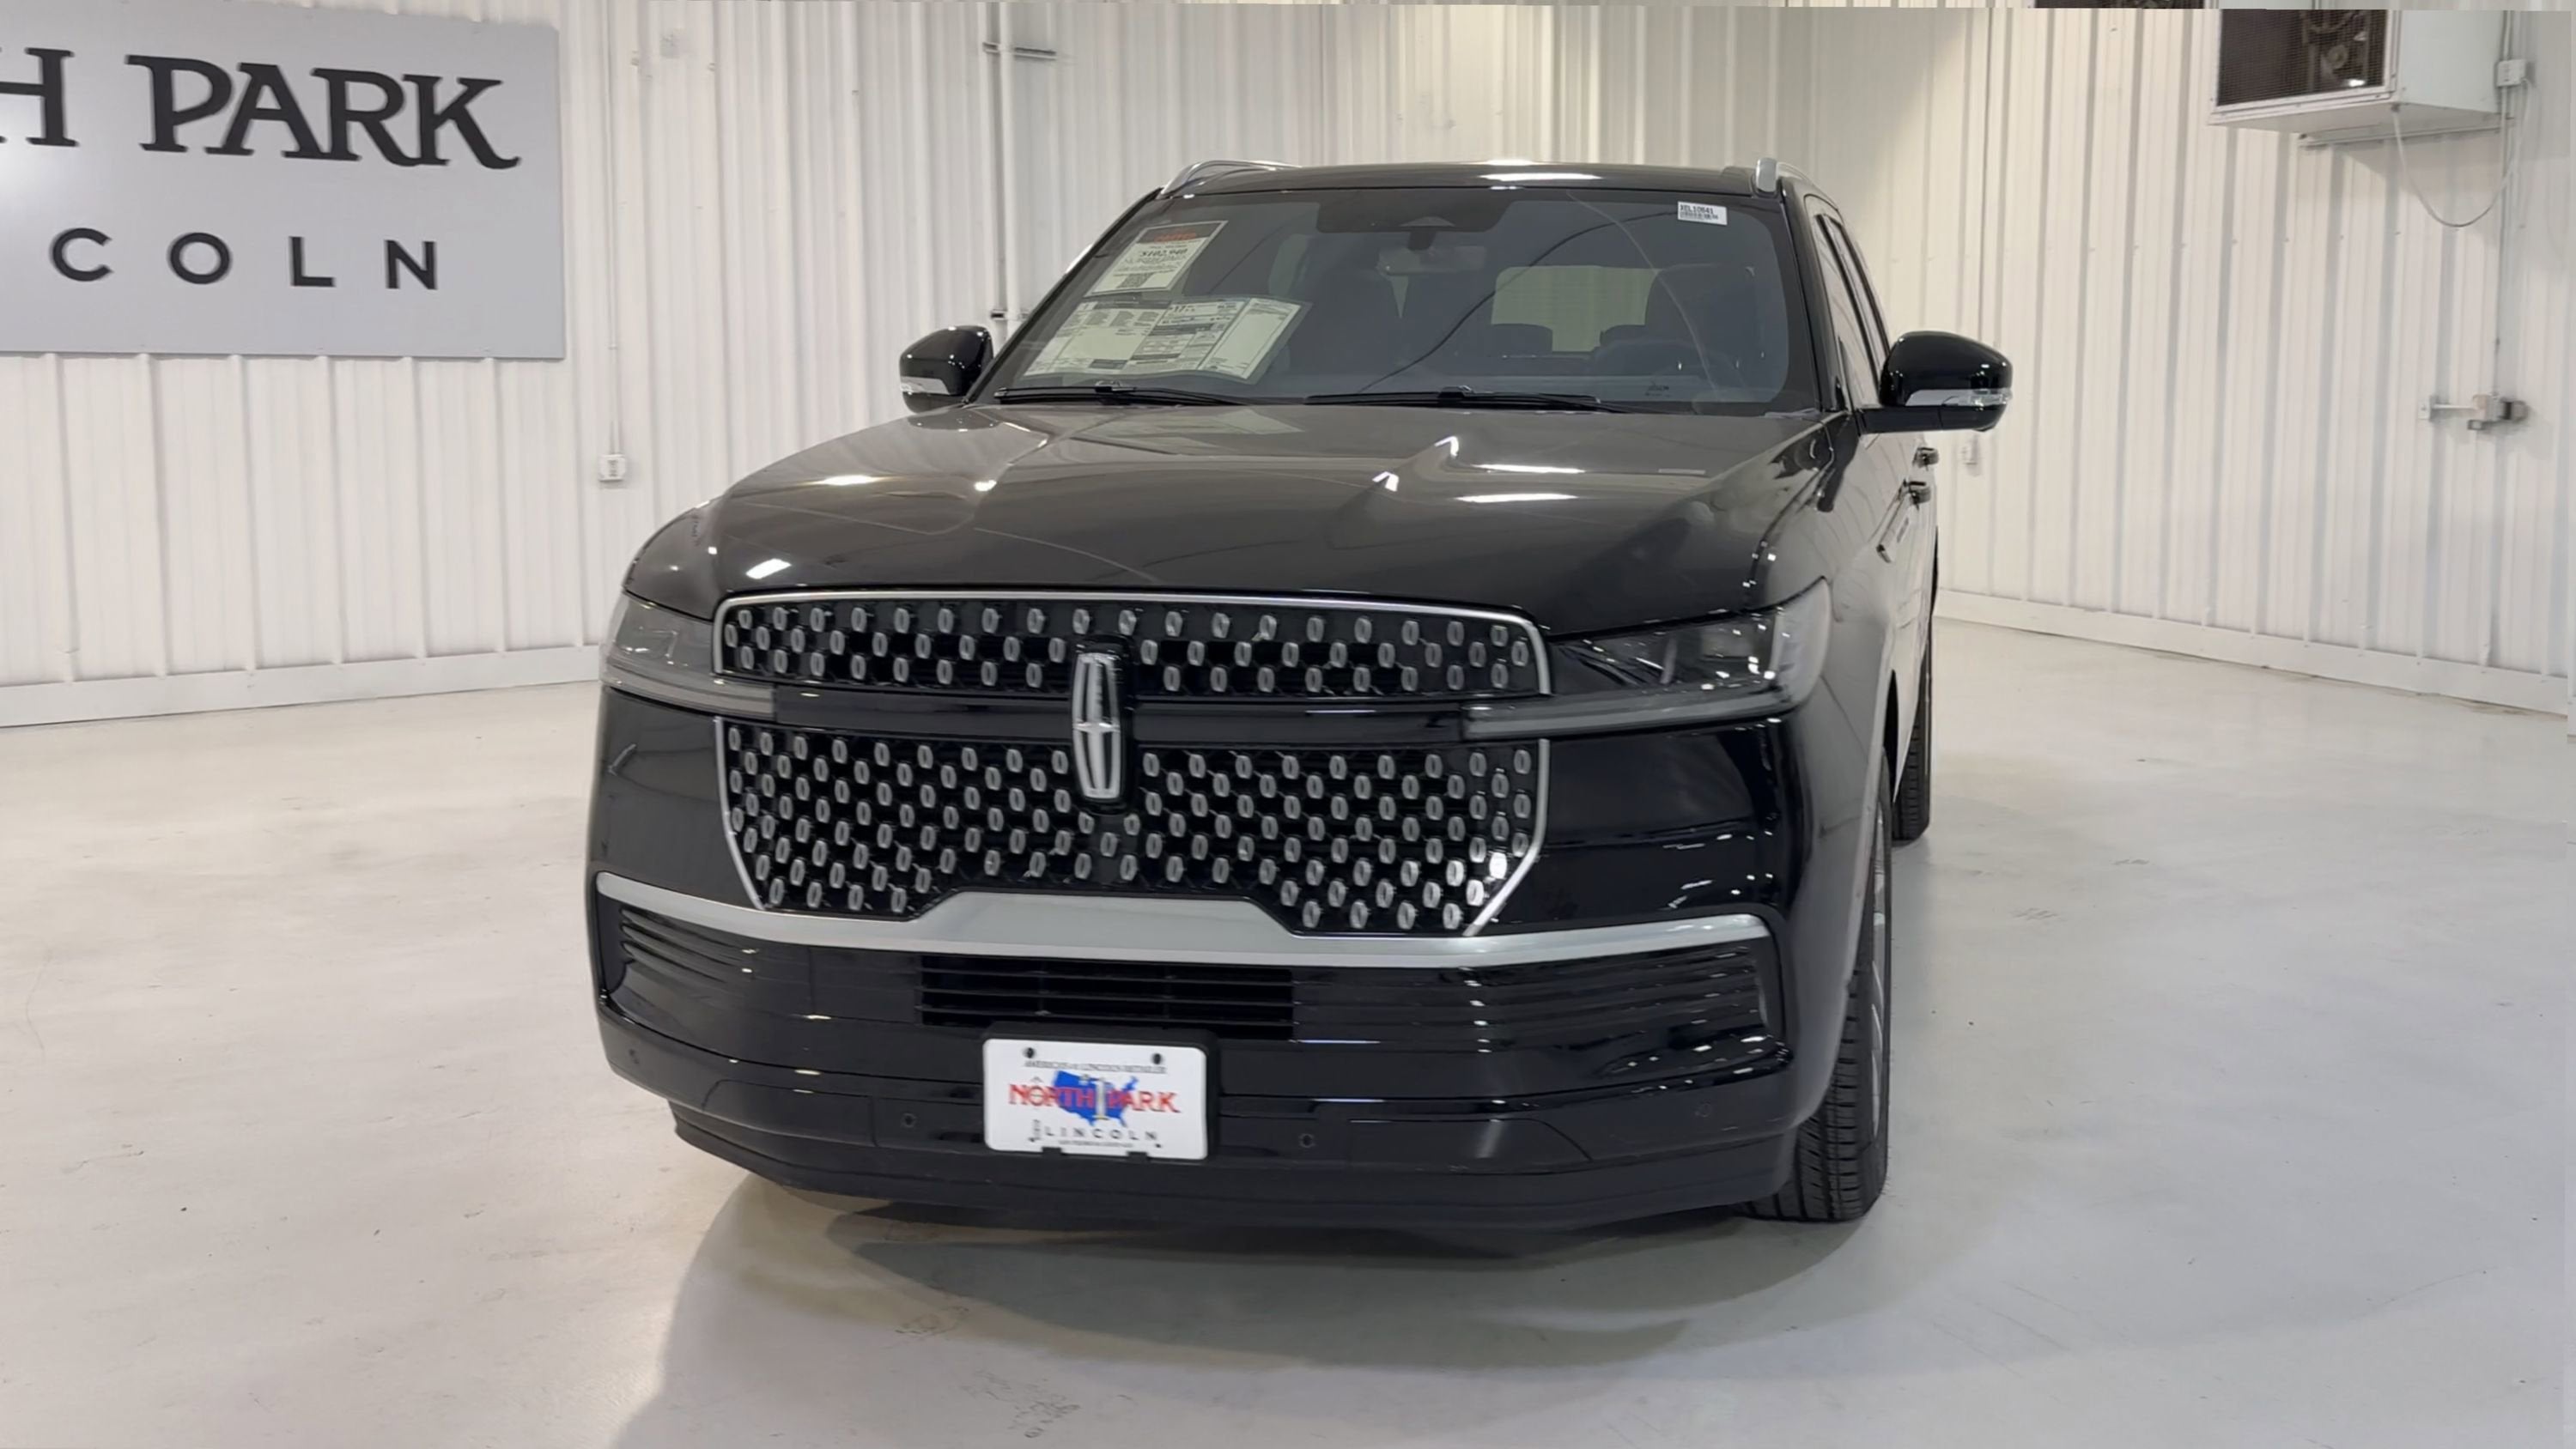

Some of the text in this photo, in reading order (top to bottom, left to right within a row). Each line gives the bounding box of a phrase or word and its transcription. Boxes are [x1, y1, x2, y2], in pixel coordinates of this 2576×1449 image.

[125, 54, 522, 170] PARK
[1008, 1083, 1182, 1113] NORTH PARK
[1045, 1125, 1157, 1140] LINCOLN
